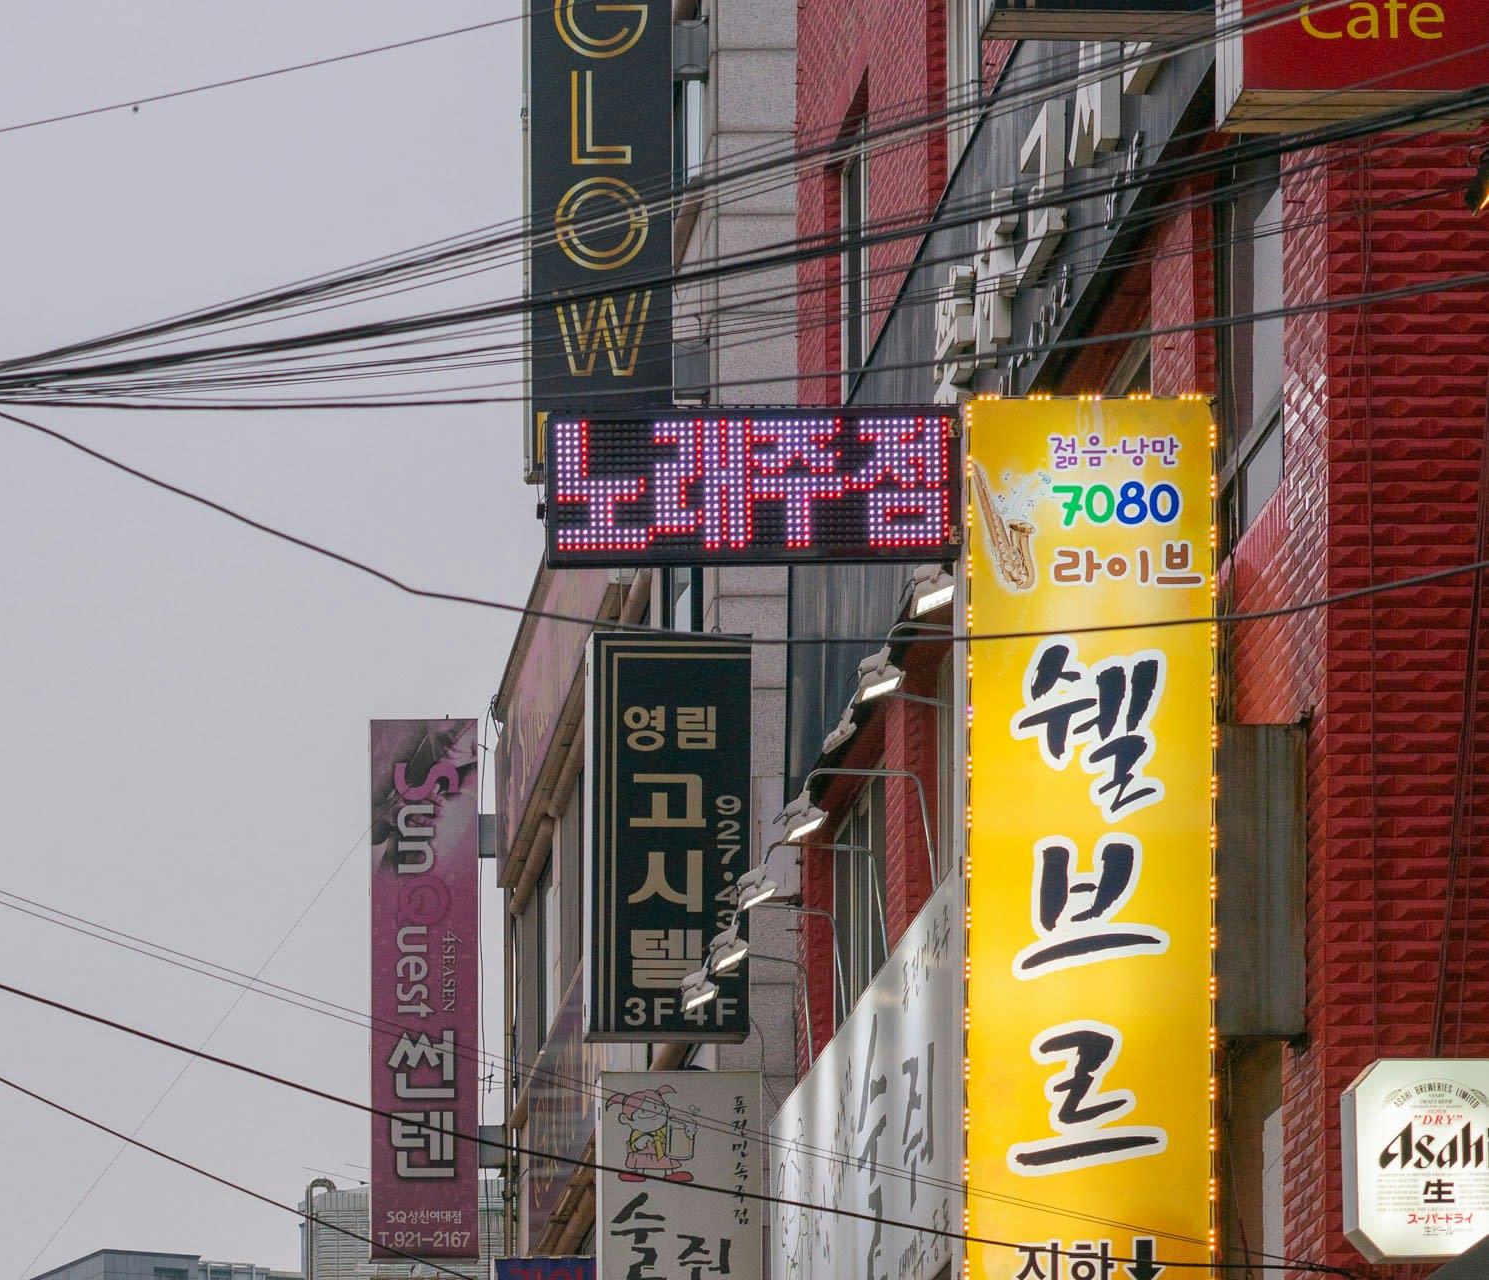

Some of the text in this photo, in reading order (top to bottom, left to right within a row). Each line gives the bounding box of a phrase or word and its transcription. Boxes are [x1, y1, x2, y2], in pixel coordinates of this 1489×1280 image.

[552, 0, 653, 377] GLOW
[555, 415, 952, 552] 노래주점
[1051, 483, 1181, 529] 7080
[1051, 546, 1206, 590] 라이브
[623, 705, 717, 752] 영림
[627, 772, 707, 991] 고시텔
[1014, 640, 1166, 1170] 쉘브르
[388, 1029, 458, 1180] 썬텐
[1415, 1082, 1480, 1110] BREWERIES LIMITED
[1423, 1179, 1455, 1204] 生
[377, 1229, 472, 1251] T.921-2167
[1407, 1213, 1474, 1224] スーパードライ
